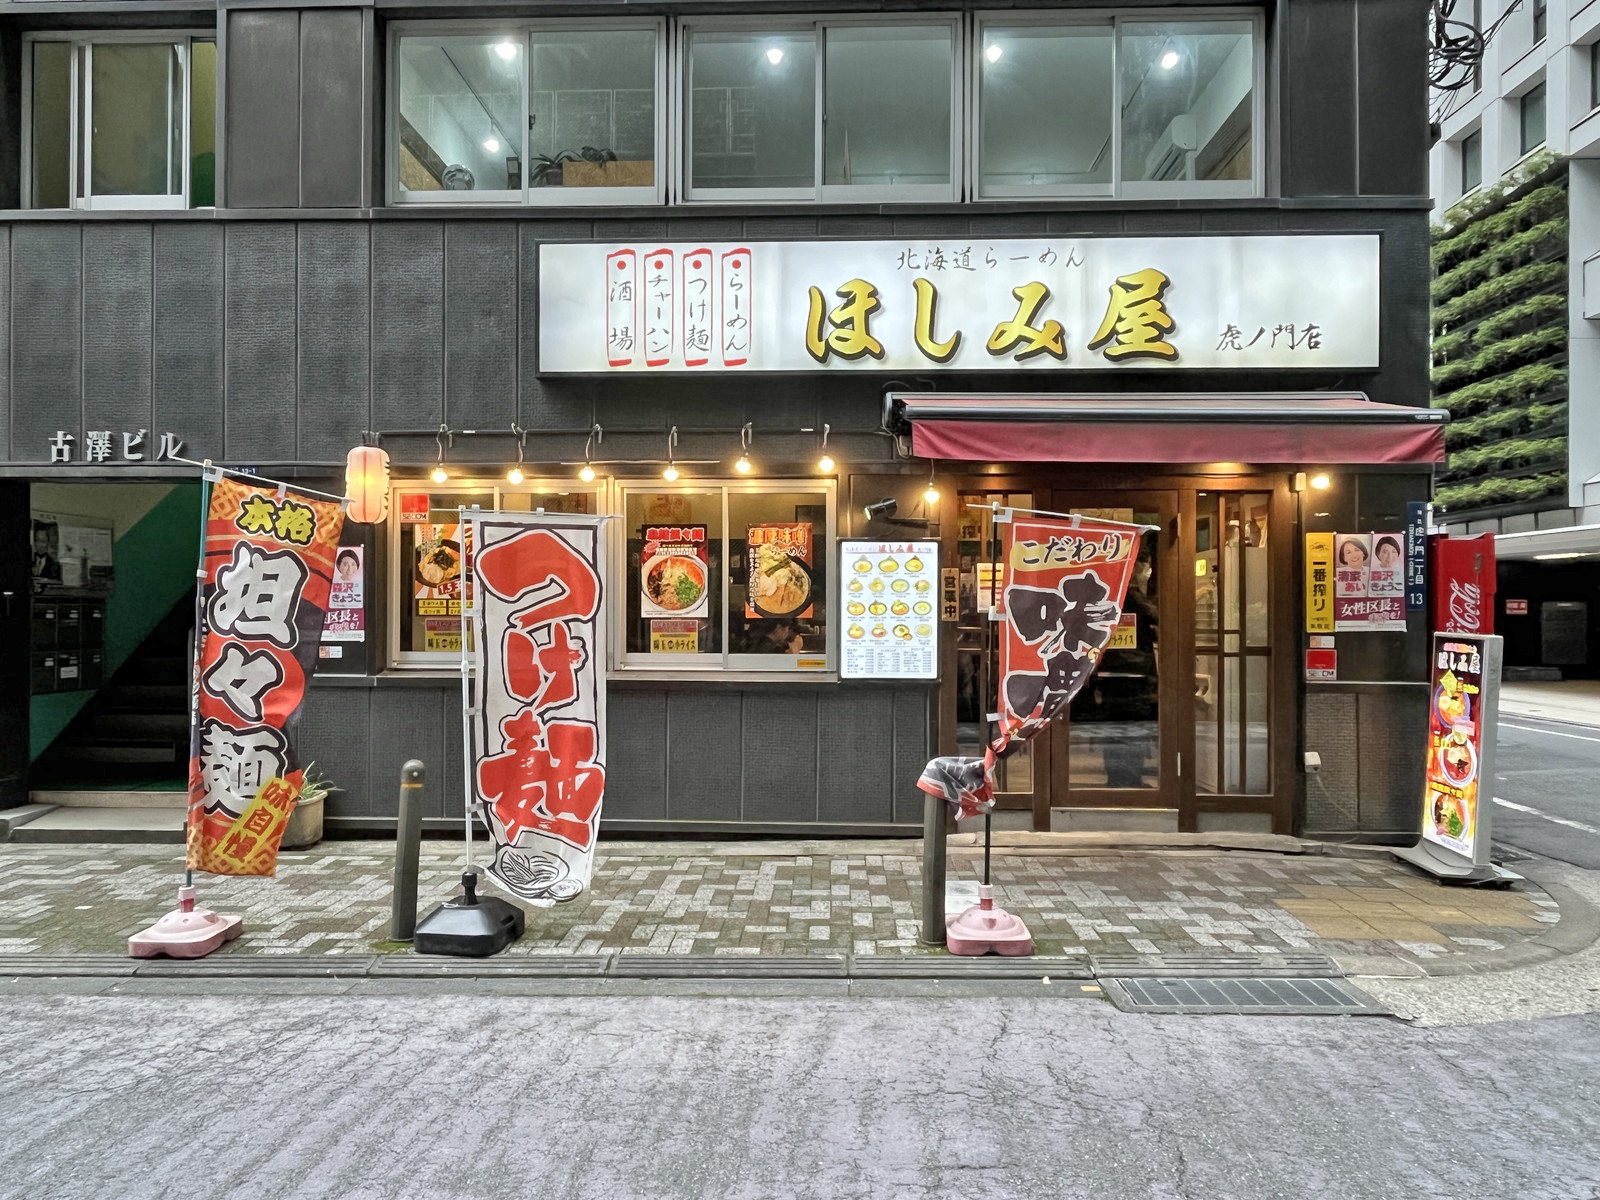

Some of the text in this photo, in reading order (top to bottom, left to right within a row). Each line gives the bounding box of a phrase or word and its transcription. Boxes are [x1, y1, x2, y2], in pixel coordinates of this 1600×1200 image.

[897, 247, 1084, 272] 北海道らーめん
[608, 280, 635, 352] 酒場
[647, 274, 672, 353] チャーハン
[686, 277, 710, 352] つけ麺
[727, 273, 749, 352] らーめん
[806, 267, 1180, 364] ほしみ屋
[1215, 323, 1323, 352] 虎ノ門店
[48, 429, 184, 463] 古澤ビル
[237, 496, 316, 545] 本格
[401, 513, 428, 521] SECOM
[771, 546, 808, 557] らーめん
[1021, 533, 1123, 565] こだわり
[1415, 526, 1425, 585] 虎ノ門一丁目
[332, 593, 361, 603] きょうこ
[1312, 561, 1327, 612] 一番搾り
[1345, 582, 1366, 592] あい
[1371, 582, 1403, 591] きょうこ
[1410, 593, 1423, 605] 13
[324, 609, 359, 624] 区長と
[1341, 598, 1401, 617] 女性区長と
[1438, 651, 1481, 675] ほしみ屋
[476, 530, 605, 852] つけ麺
[215, 777, 298, 865] 味自慢
